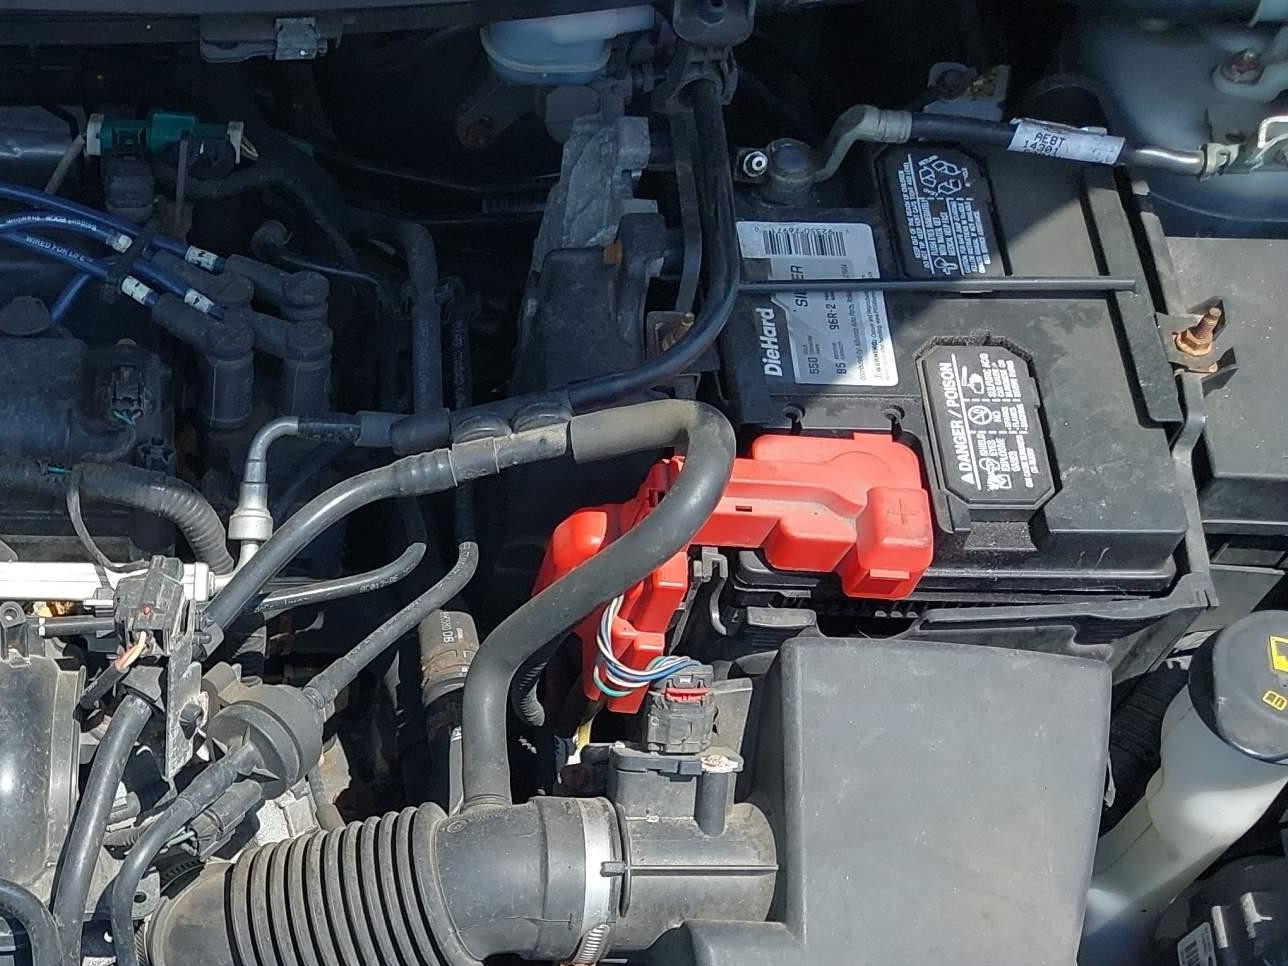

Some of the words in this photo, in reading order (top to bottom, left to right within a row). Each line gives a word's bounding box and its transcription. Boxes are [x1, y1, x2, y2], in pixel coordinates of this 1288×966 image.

[790, 265, 809, 308] SILER
[826, 304, 840, 330] 96R-2
[755, 307, 783, 377] DieHard
[807, 356, 821, 376] 550
[980, 353, 990, 368] ACID
[939, 362, 960, 407] POISON
[983, 369, 997, 398] SULFURIC
[993, 410, 1001, 422] NO
[951, 420, 972, 471] DANGER
[976, 434, 987, 456] SHIELD
[987, 440, 998, 456] EYES
[996, 437, 1010, 471] EXPLOSIVE
[1008, 451, 1020, 472] GASES
